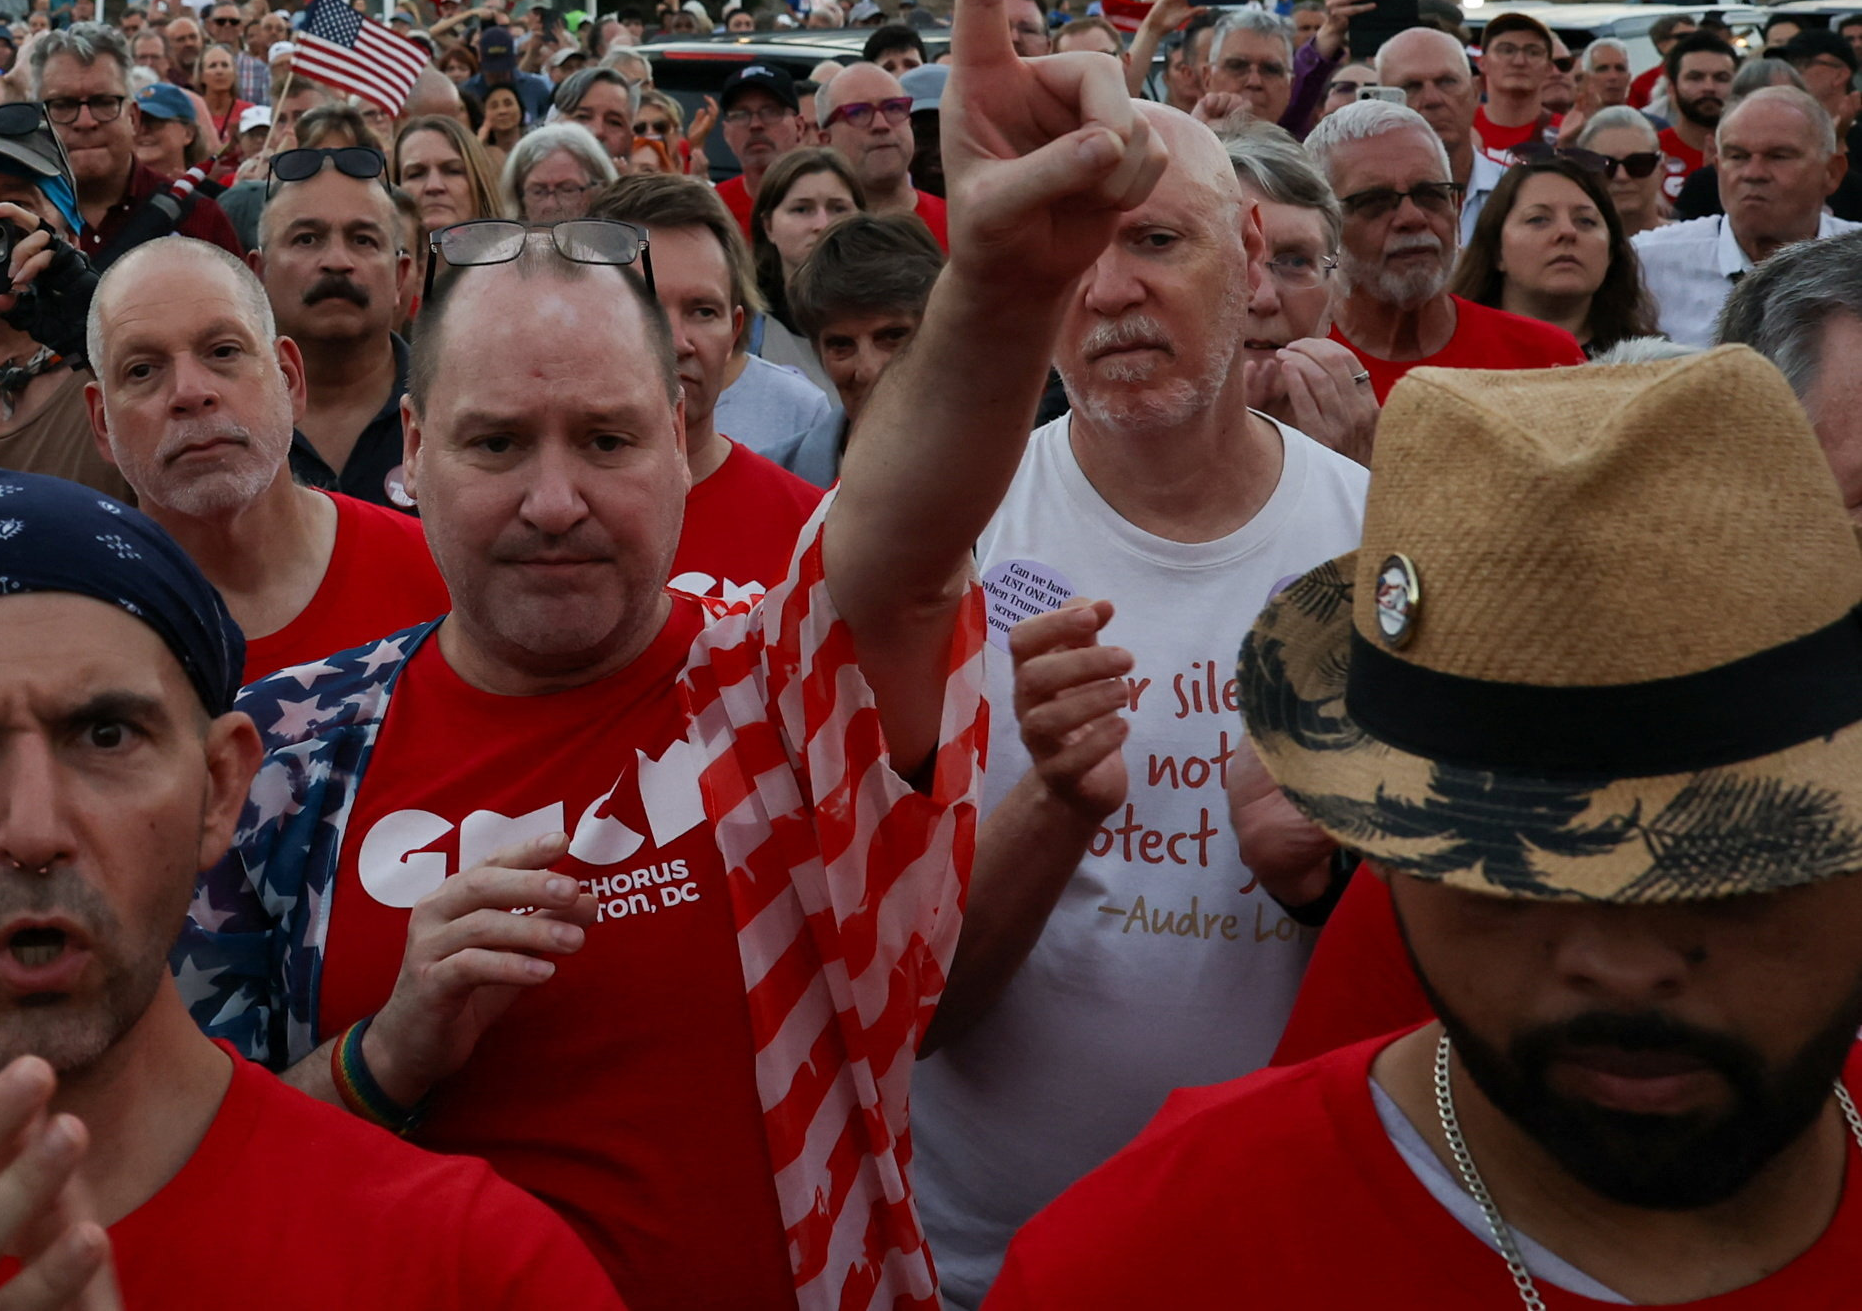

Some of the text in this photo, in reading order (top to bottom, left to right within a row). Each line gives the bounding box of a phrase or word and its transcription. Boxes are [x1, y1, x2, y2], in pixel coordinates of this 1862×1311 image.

[982, 580, 1008, 601] when
[999, 574, 1063, 610] JUST ONE DA
[1010, 563, 1071, 599] Can we have
[992, 603, 1025, 623] screw
[1148, 731, 1236, 789] not
[660, 881, 701, 908] DC
[1254, 901, 1300, 943] Lo
